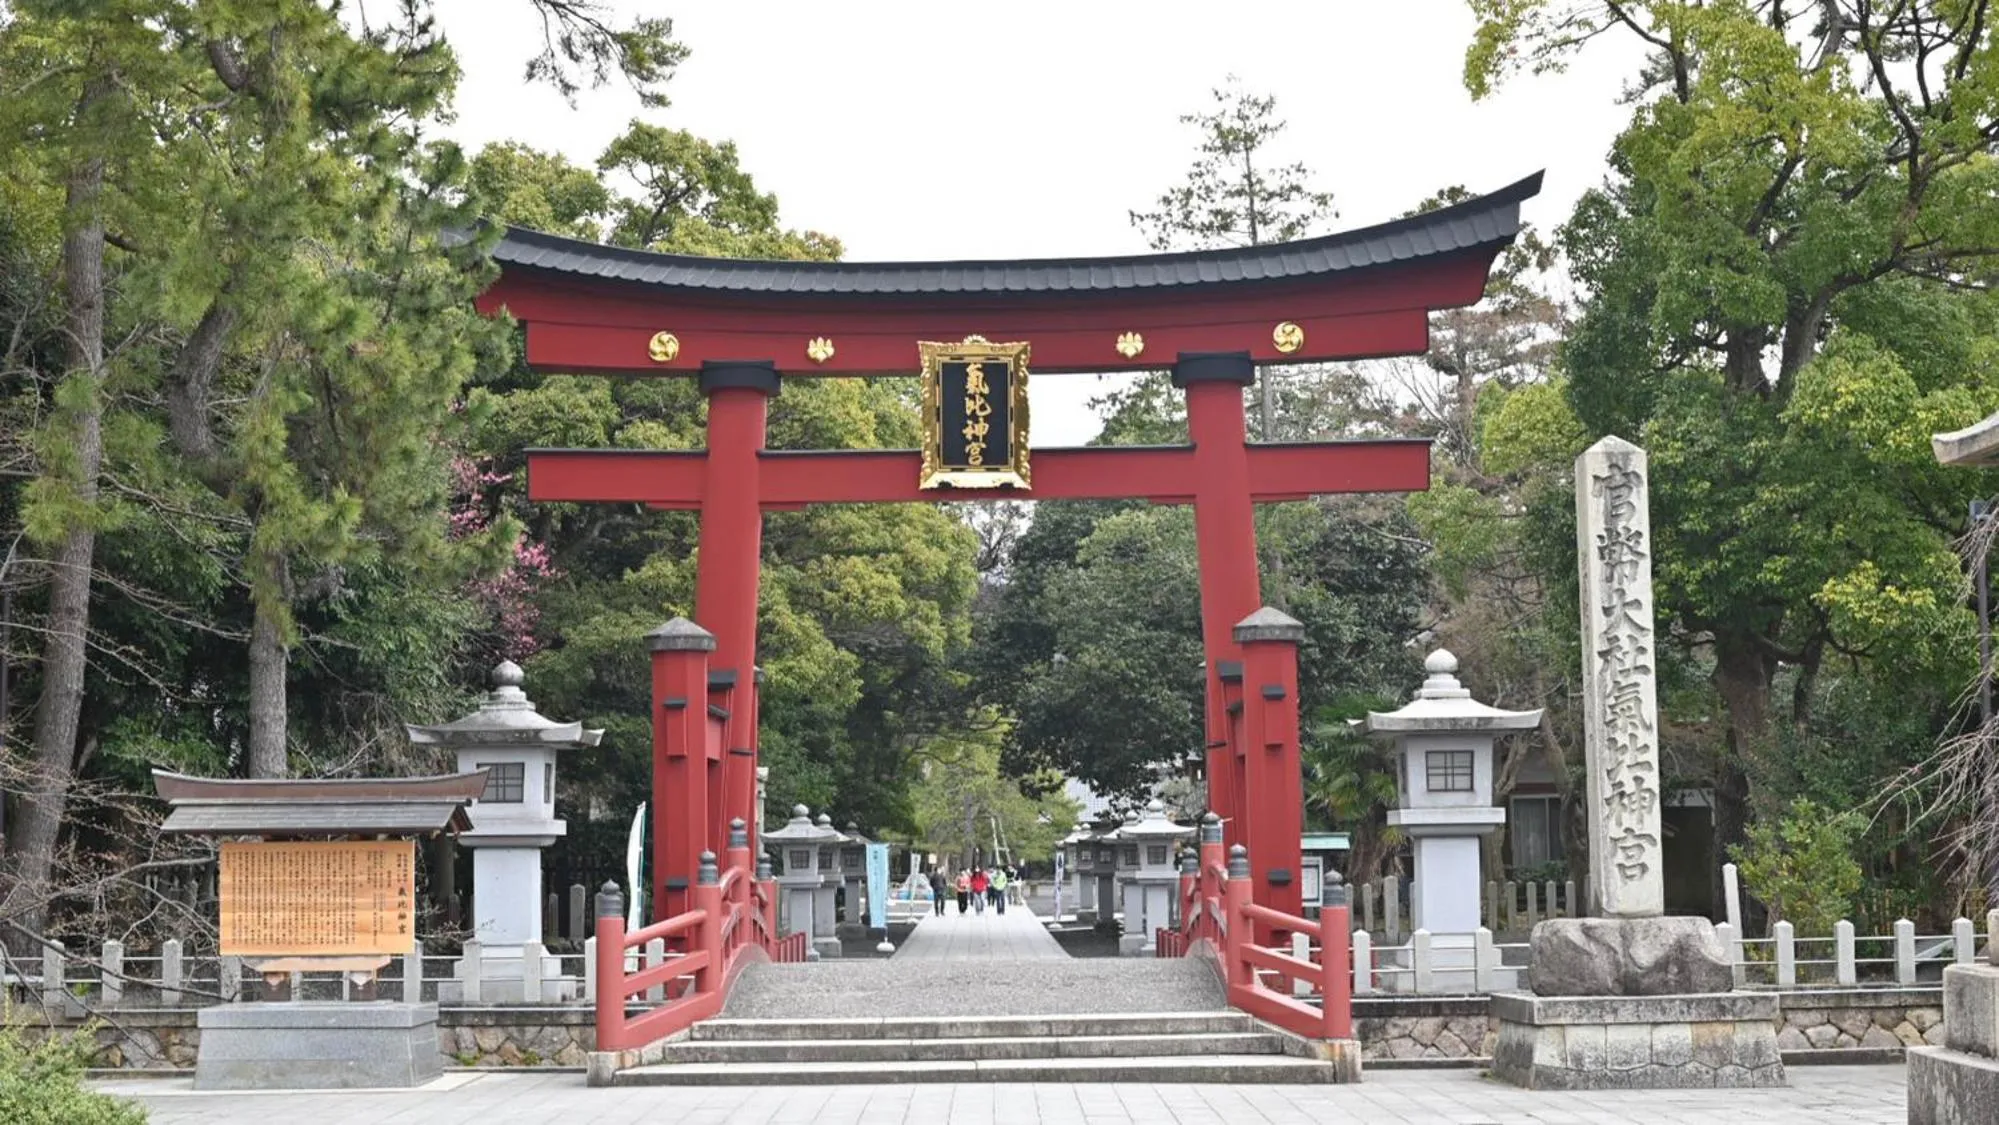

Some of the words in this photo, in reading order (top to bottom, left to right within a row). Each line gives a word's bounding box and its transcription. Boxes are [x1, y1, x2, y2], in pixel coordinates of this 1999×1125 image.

[962, 363, 992, 466] 氣比神宮
[1592, 463, 1656, 882] 官幣大社氣比神宮
